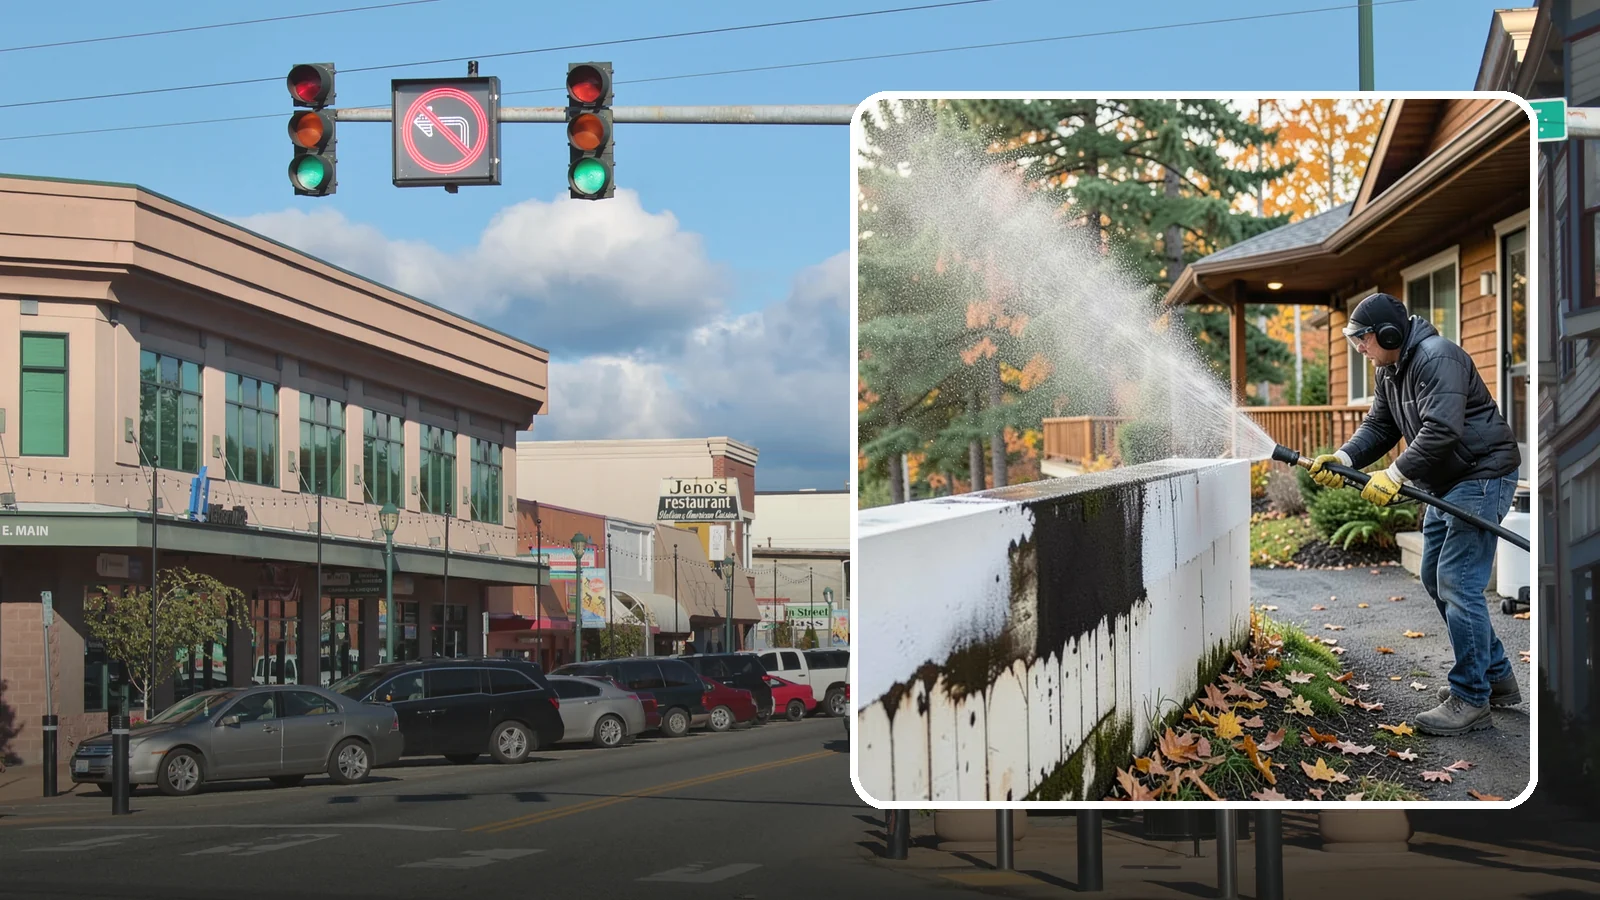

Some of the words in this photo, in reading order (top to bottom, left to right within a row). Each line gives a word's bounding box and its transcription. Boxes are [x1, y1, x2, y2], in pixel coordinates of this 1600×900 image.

[670, 480, 727, 494] Jeno's
[665, 496, 731, 509] restaurant
[659, 510, 682, 519] Italian
[686, 510, 714, 519] American
[715, 509, 737, 519] Cuisine
[2, 525, 13, 536] E.
[15, 525, 49, 536] MAIN
[797, 607, 829, 617] Street
[790, 619, 824, 627] lass
